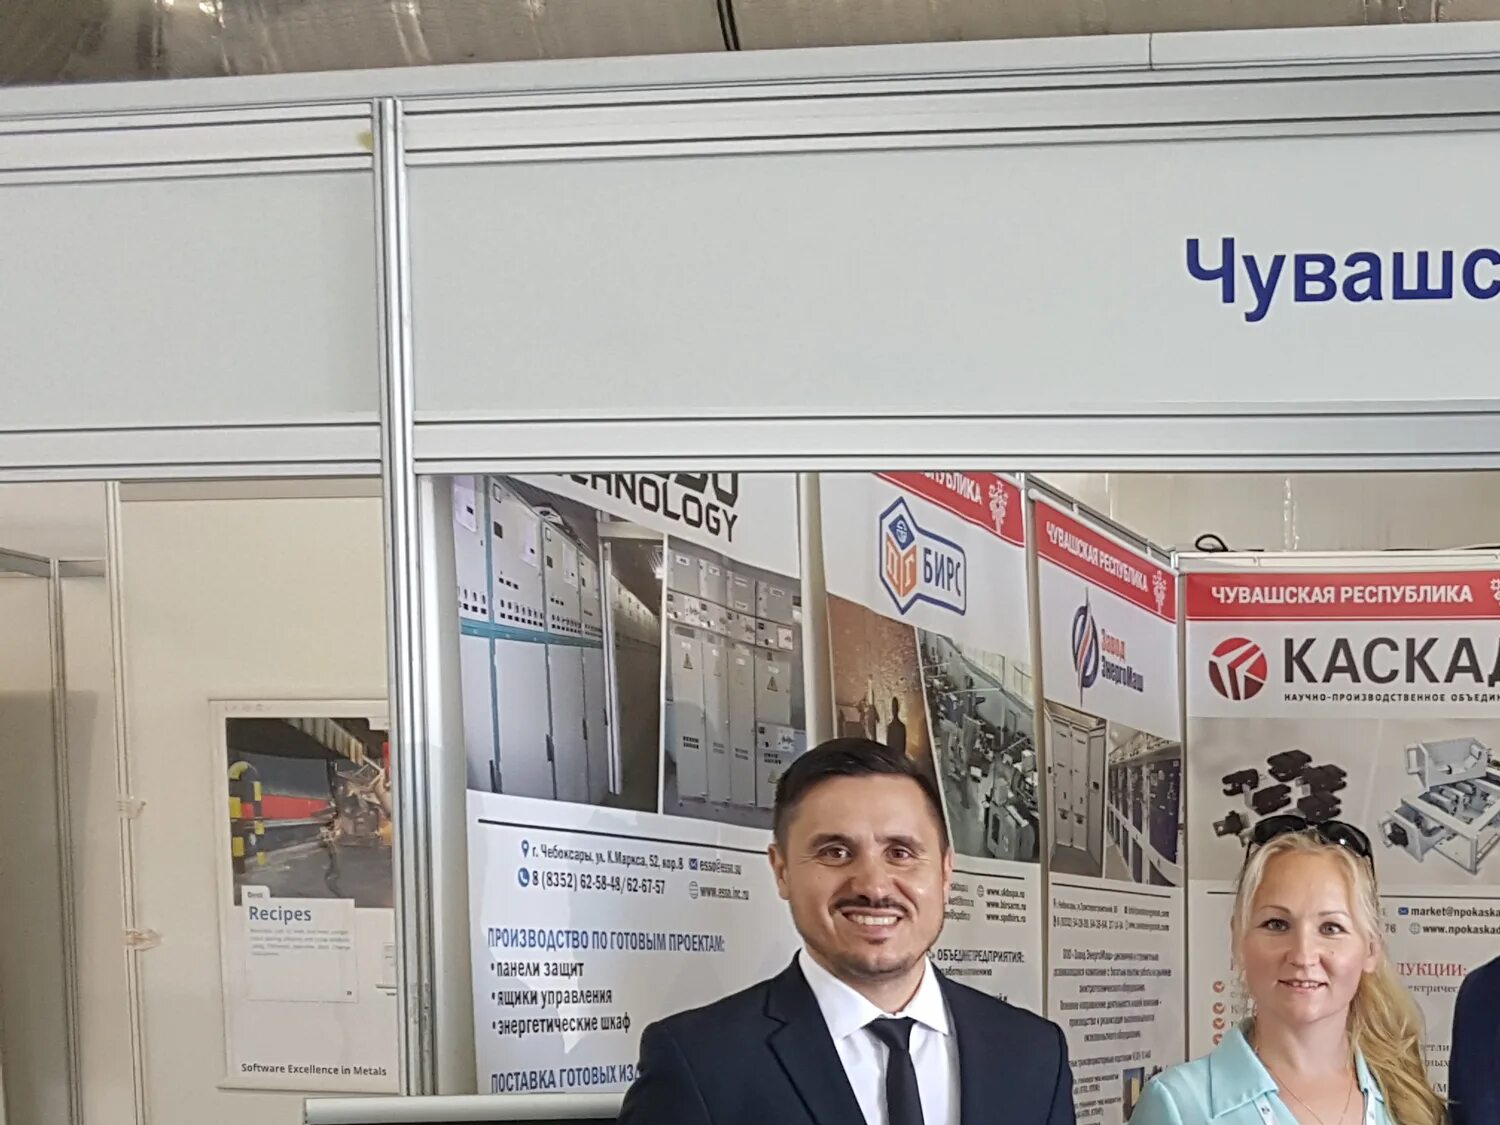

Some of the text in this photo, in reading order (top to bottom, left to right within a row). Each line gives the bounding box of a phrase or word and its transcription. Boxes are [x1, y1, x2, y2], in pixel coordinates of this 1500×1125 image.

[571, 474, 738, 542] HNOLOGY
[1046, 521, 1099, 566] ЧУВАШСКАЯ
[923, 547, 961, 597] БИРС
[1212, 584, 1473, 605] ЧУВАШСКАЯ РЕСПУБЛИКА
[1284, 693, 1446, 703] НАУЧНО-ПРОИЗВОДСТВЕННОЕ
[532, 871, 578, 890] 8 (8352)
[249, 906, 311, 925] Recipes
[488, 927, 725, 952] ПРОИЗВОДСТВО ПО ГОТОВЫМ ПРОЕКТАМ:
[497, 961, 584, 979] панели защит
[497, 988, 612, 1008] ящики управления
[498, 1012, 631, 1038] энергетические шкаф
[241, 1063, 387, 1076] Software Excellence in Metals
[491, 1065, 616, 1093] ПОСТАВКА ГОТОВЫХ
